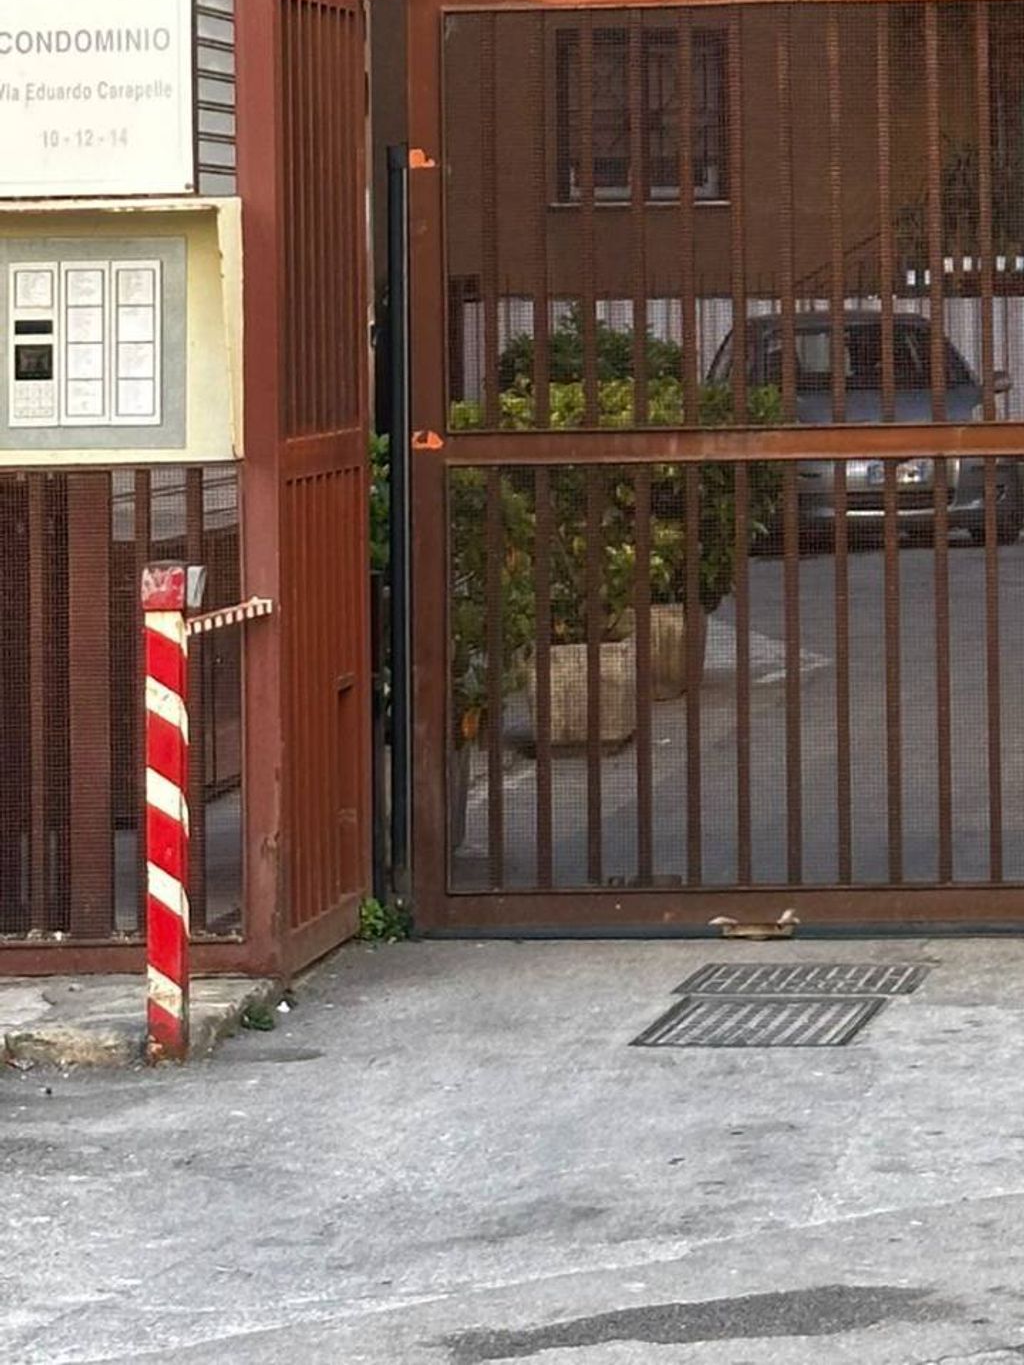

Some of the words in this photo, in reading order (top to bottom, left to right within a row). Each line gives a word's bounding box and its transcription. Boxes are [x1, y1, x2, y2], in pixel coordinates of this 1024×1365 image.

[0, 27, 171, 55] CONDOMINIO
[25, 81, 92, 101] Eduardo
[42, 129, 59, 148] 10
[75, 128, 94, 147] 12
[110, 127, 128, 146] 14
